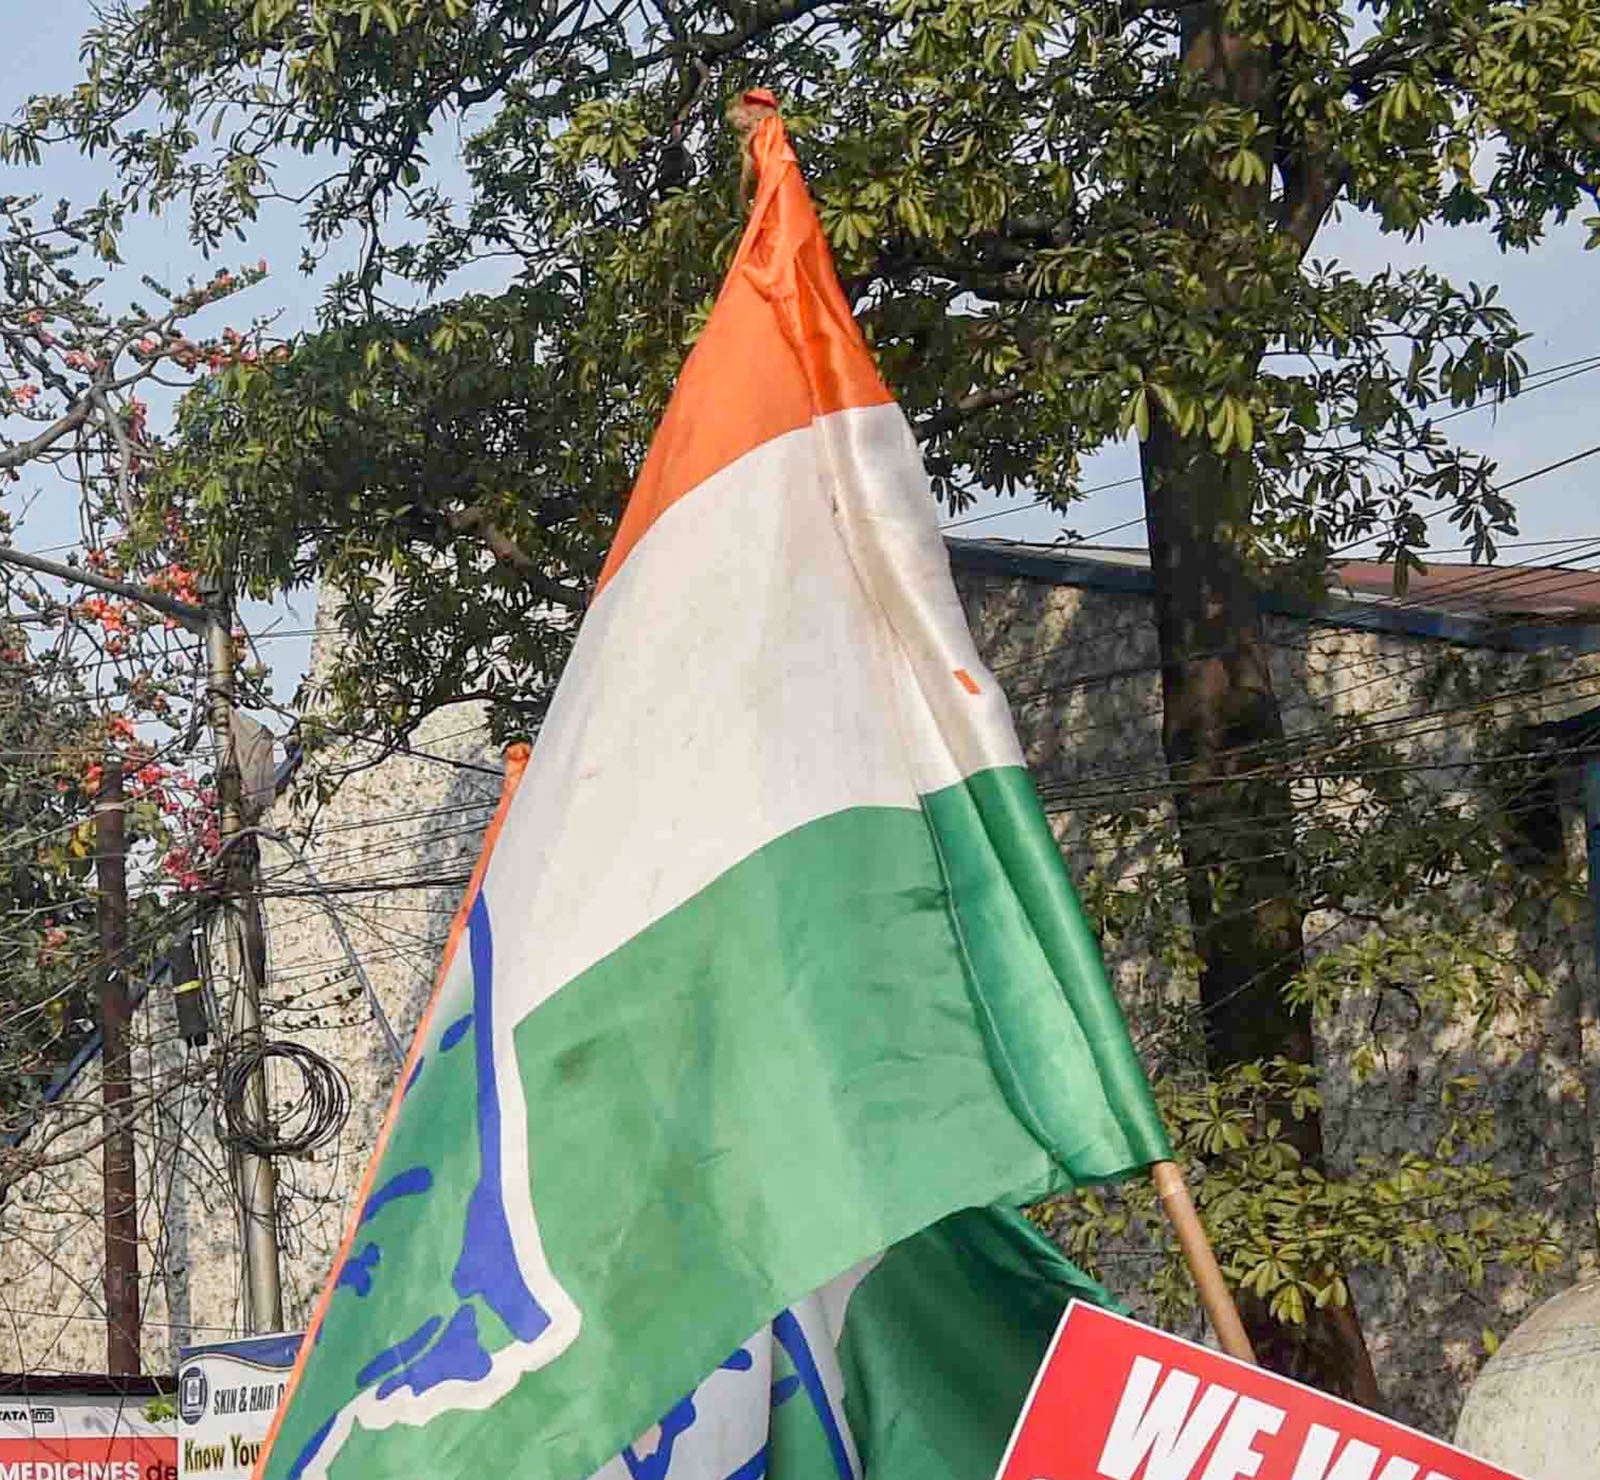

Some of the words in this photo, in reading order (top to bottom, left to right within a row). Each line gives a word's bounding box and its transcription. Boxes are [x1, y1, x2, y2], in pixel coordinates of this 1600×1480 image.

[213, 1389, 236, 1415] SKIN
[239, 1386, 248, 1412] &
[184, 1439, 226, 1474] Know
[230, 1433, 260, 1467] You
